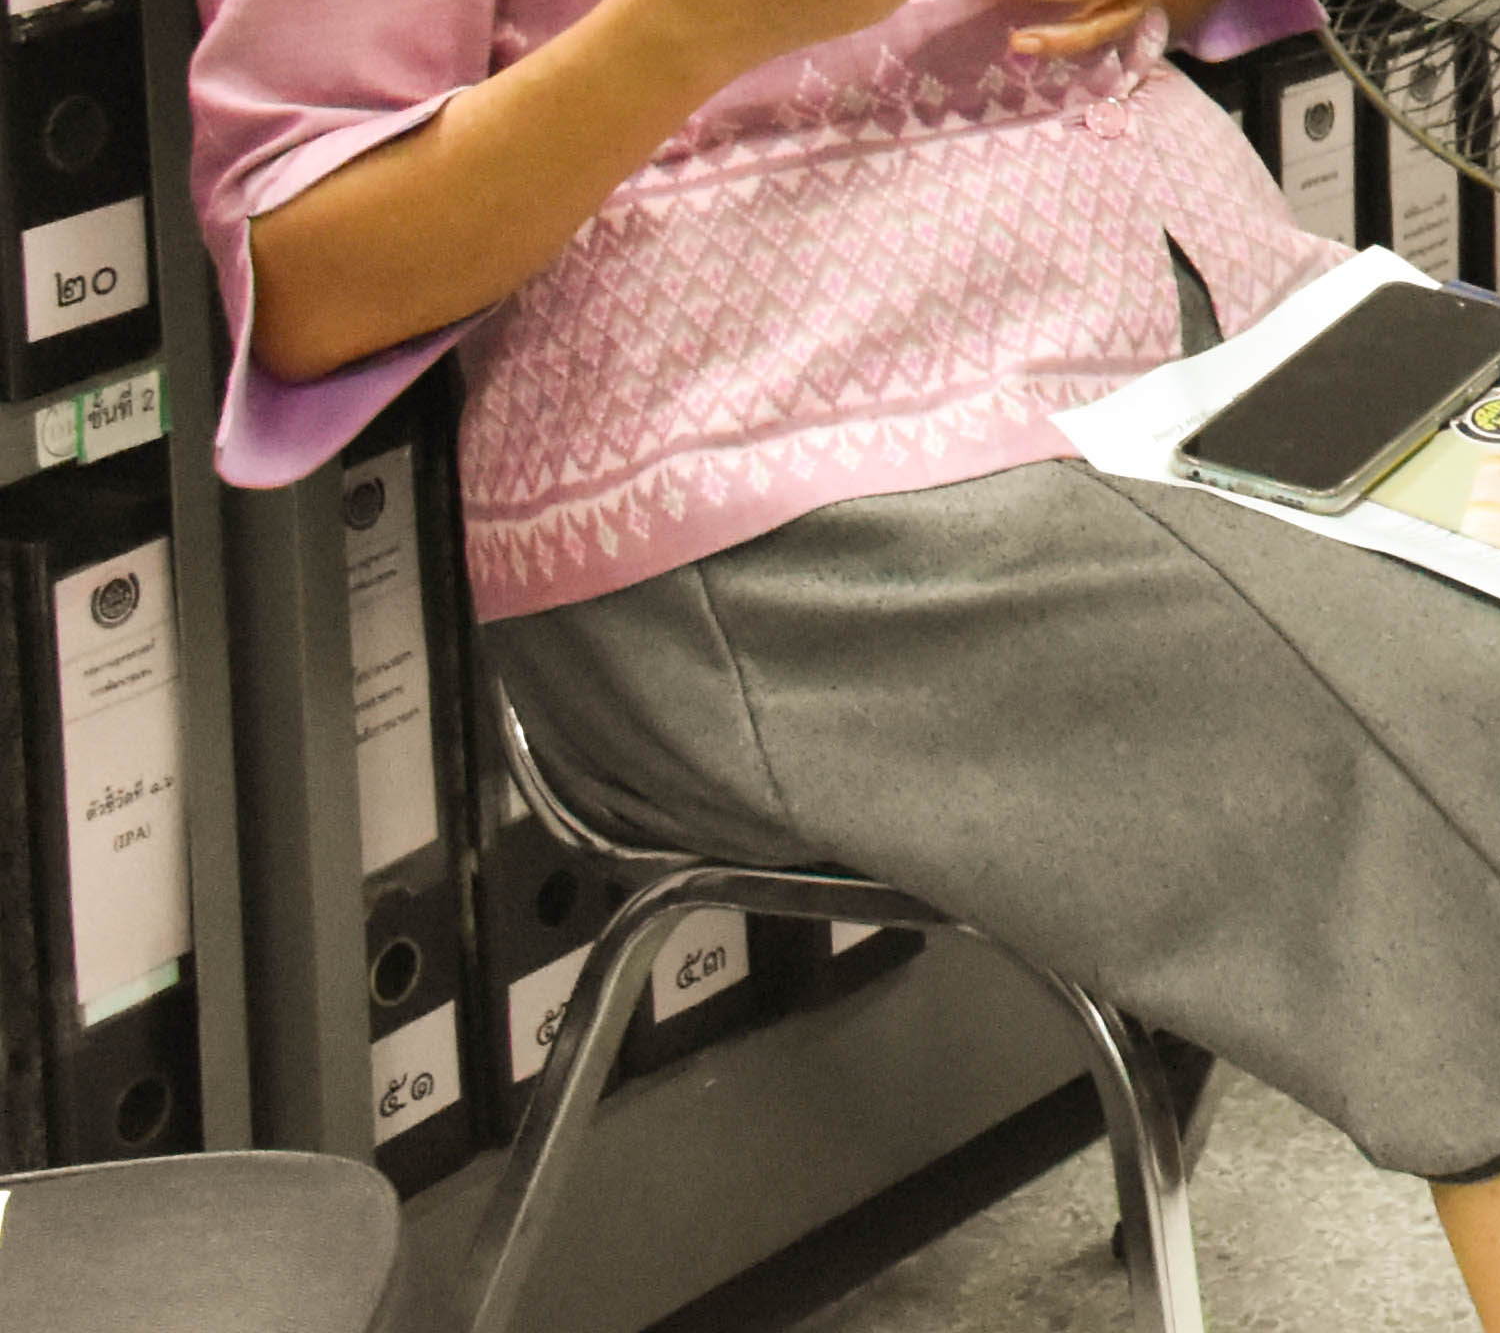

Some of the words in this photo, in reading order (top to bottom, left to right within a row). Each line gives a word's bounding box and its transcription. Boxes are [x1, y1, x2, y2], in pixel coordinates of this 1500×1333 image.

[54, 266, 118, 308] ๒๐
[141, 388, 155, 413] 2
[536, 1002, 568, 1046] ๕
